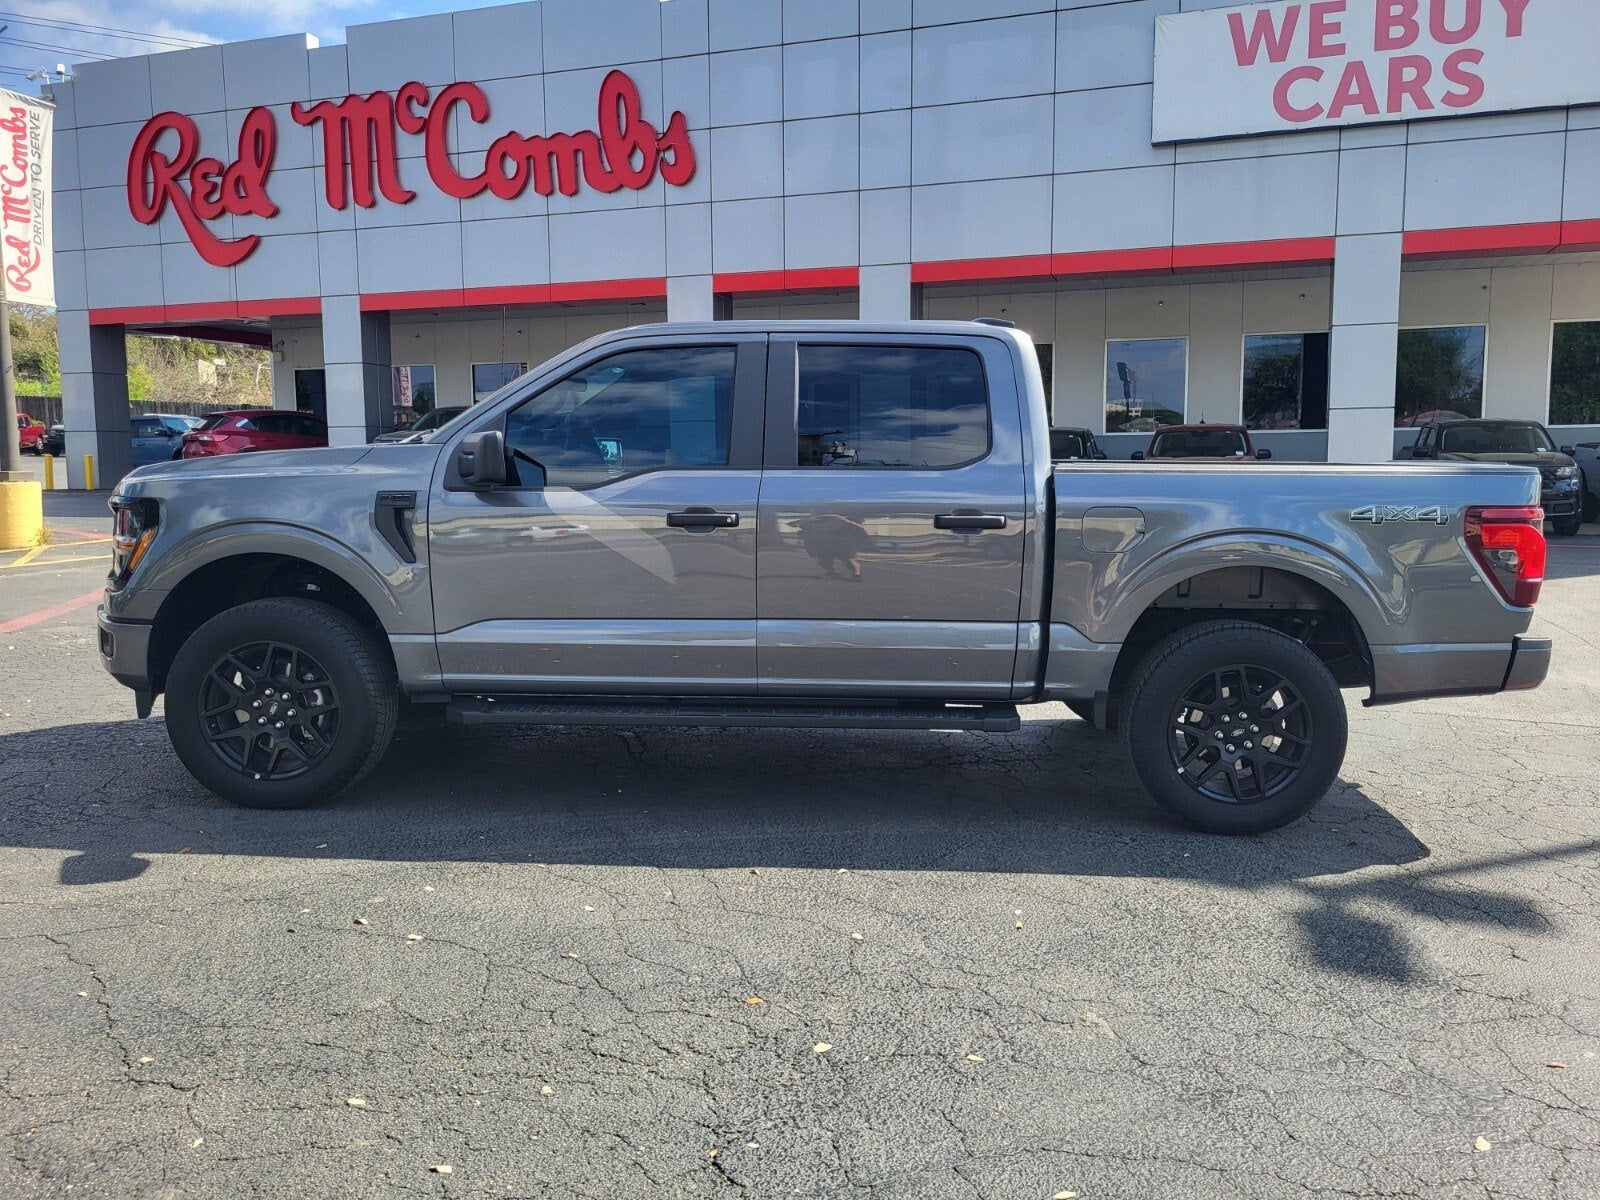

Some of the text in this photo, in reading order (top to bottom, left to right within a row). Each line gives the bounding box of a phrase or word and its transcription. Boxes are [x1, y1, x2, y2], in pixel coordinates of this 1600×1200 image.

[1227, 0, 1531, 67] WE BUY
[1272, 48, 1486, 123] CARS
[0, 106, 41, 292] Red McCombs
[30, 111, 43, 246] DRIVEN TO SERVE
[127, 69, 696, 267] Red McCombs
